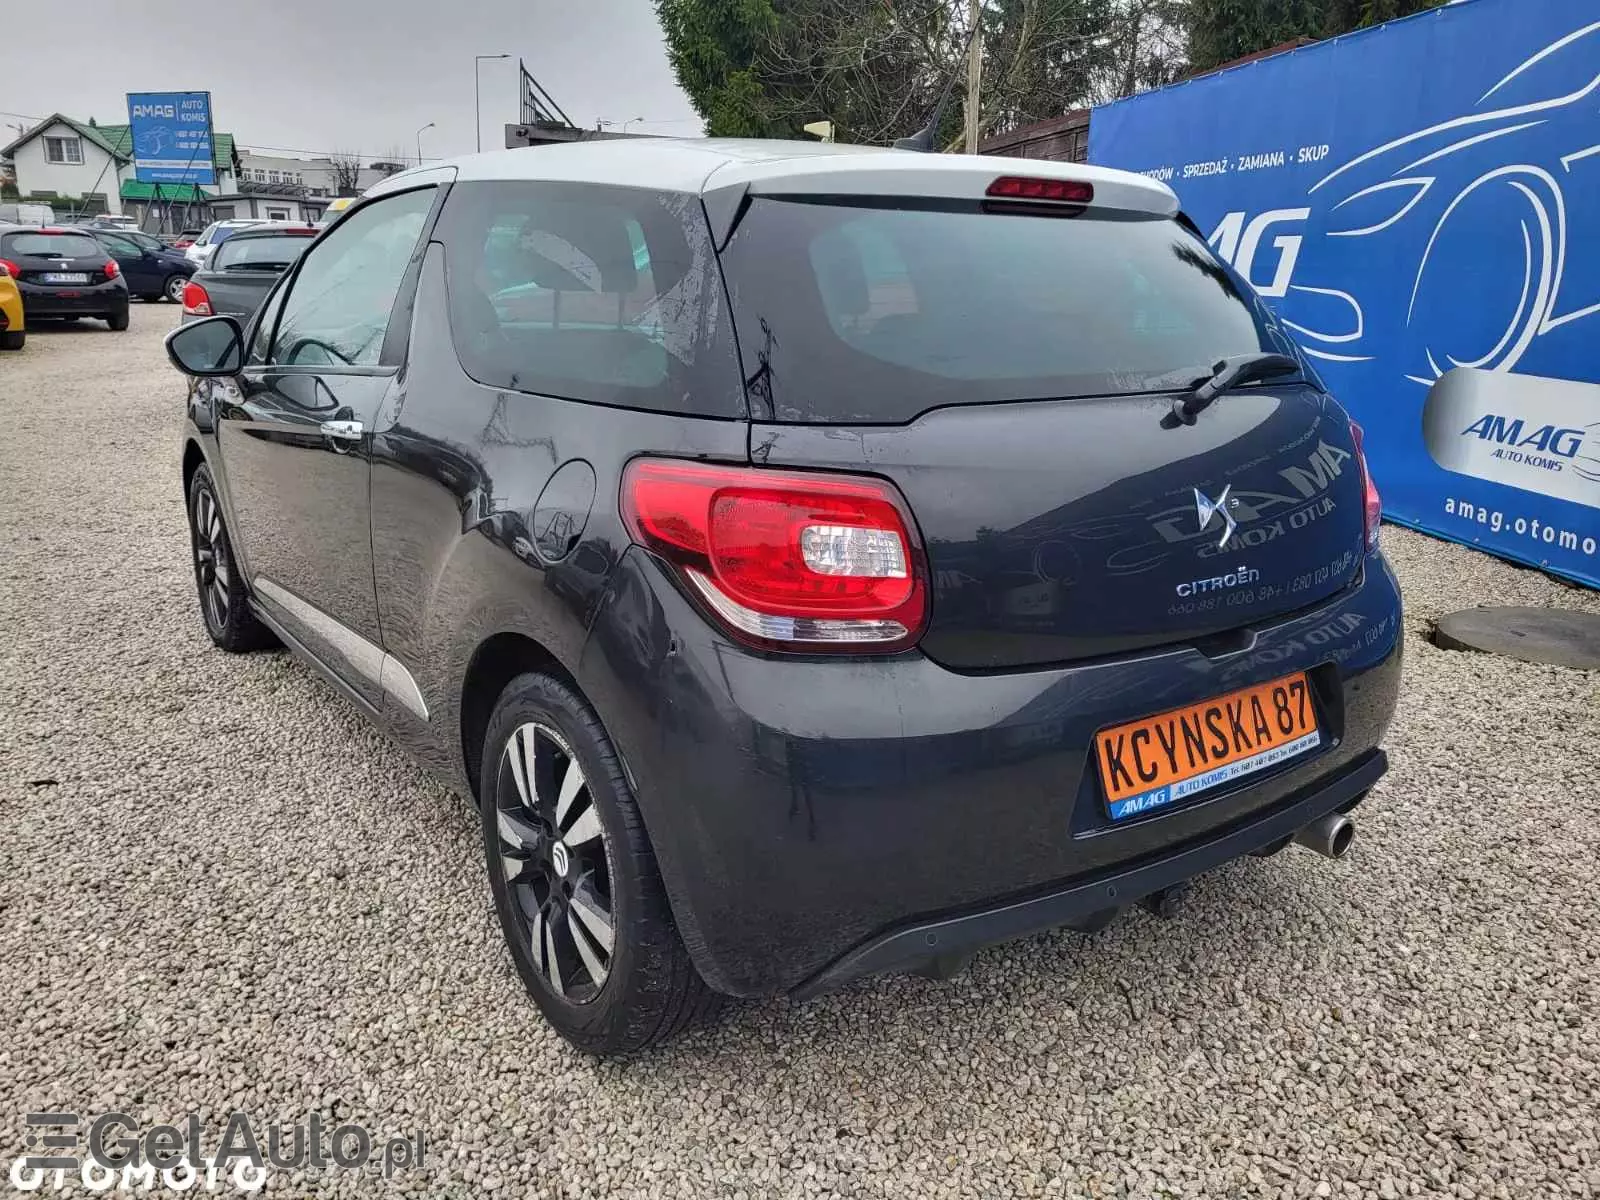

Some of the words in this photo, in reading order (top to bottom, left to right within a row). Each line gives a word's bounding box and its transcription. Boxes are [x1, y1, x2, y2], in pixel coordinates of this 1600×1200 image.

[133, 104, 174, 118] AMAG
[181, 100, 203, 110] AUTO
[181, 112, 206, 122] KOMIS
[1183, 157, 1228, 178] SPRZEDAŻ
[1238, 151, 1285, 171] ZAMIANA
[1298, 144, 1329, 163] SKUP
[1460, 414, 1586, 458] AMAG
[1490, 448, 1524, 463] AUTO
[1524, 455, 1565, 472] KOMIS
[1445, 497, 1597, 555] amag.otomo
[1104, 694, 1273, 792] KCYNSKA
[1272, 679, 1306, 736] 87
[1119, 788, 1167, 817] AMAG
[1175, 781, 1199, 797] AUTO
